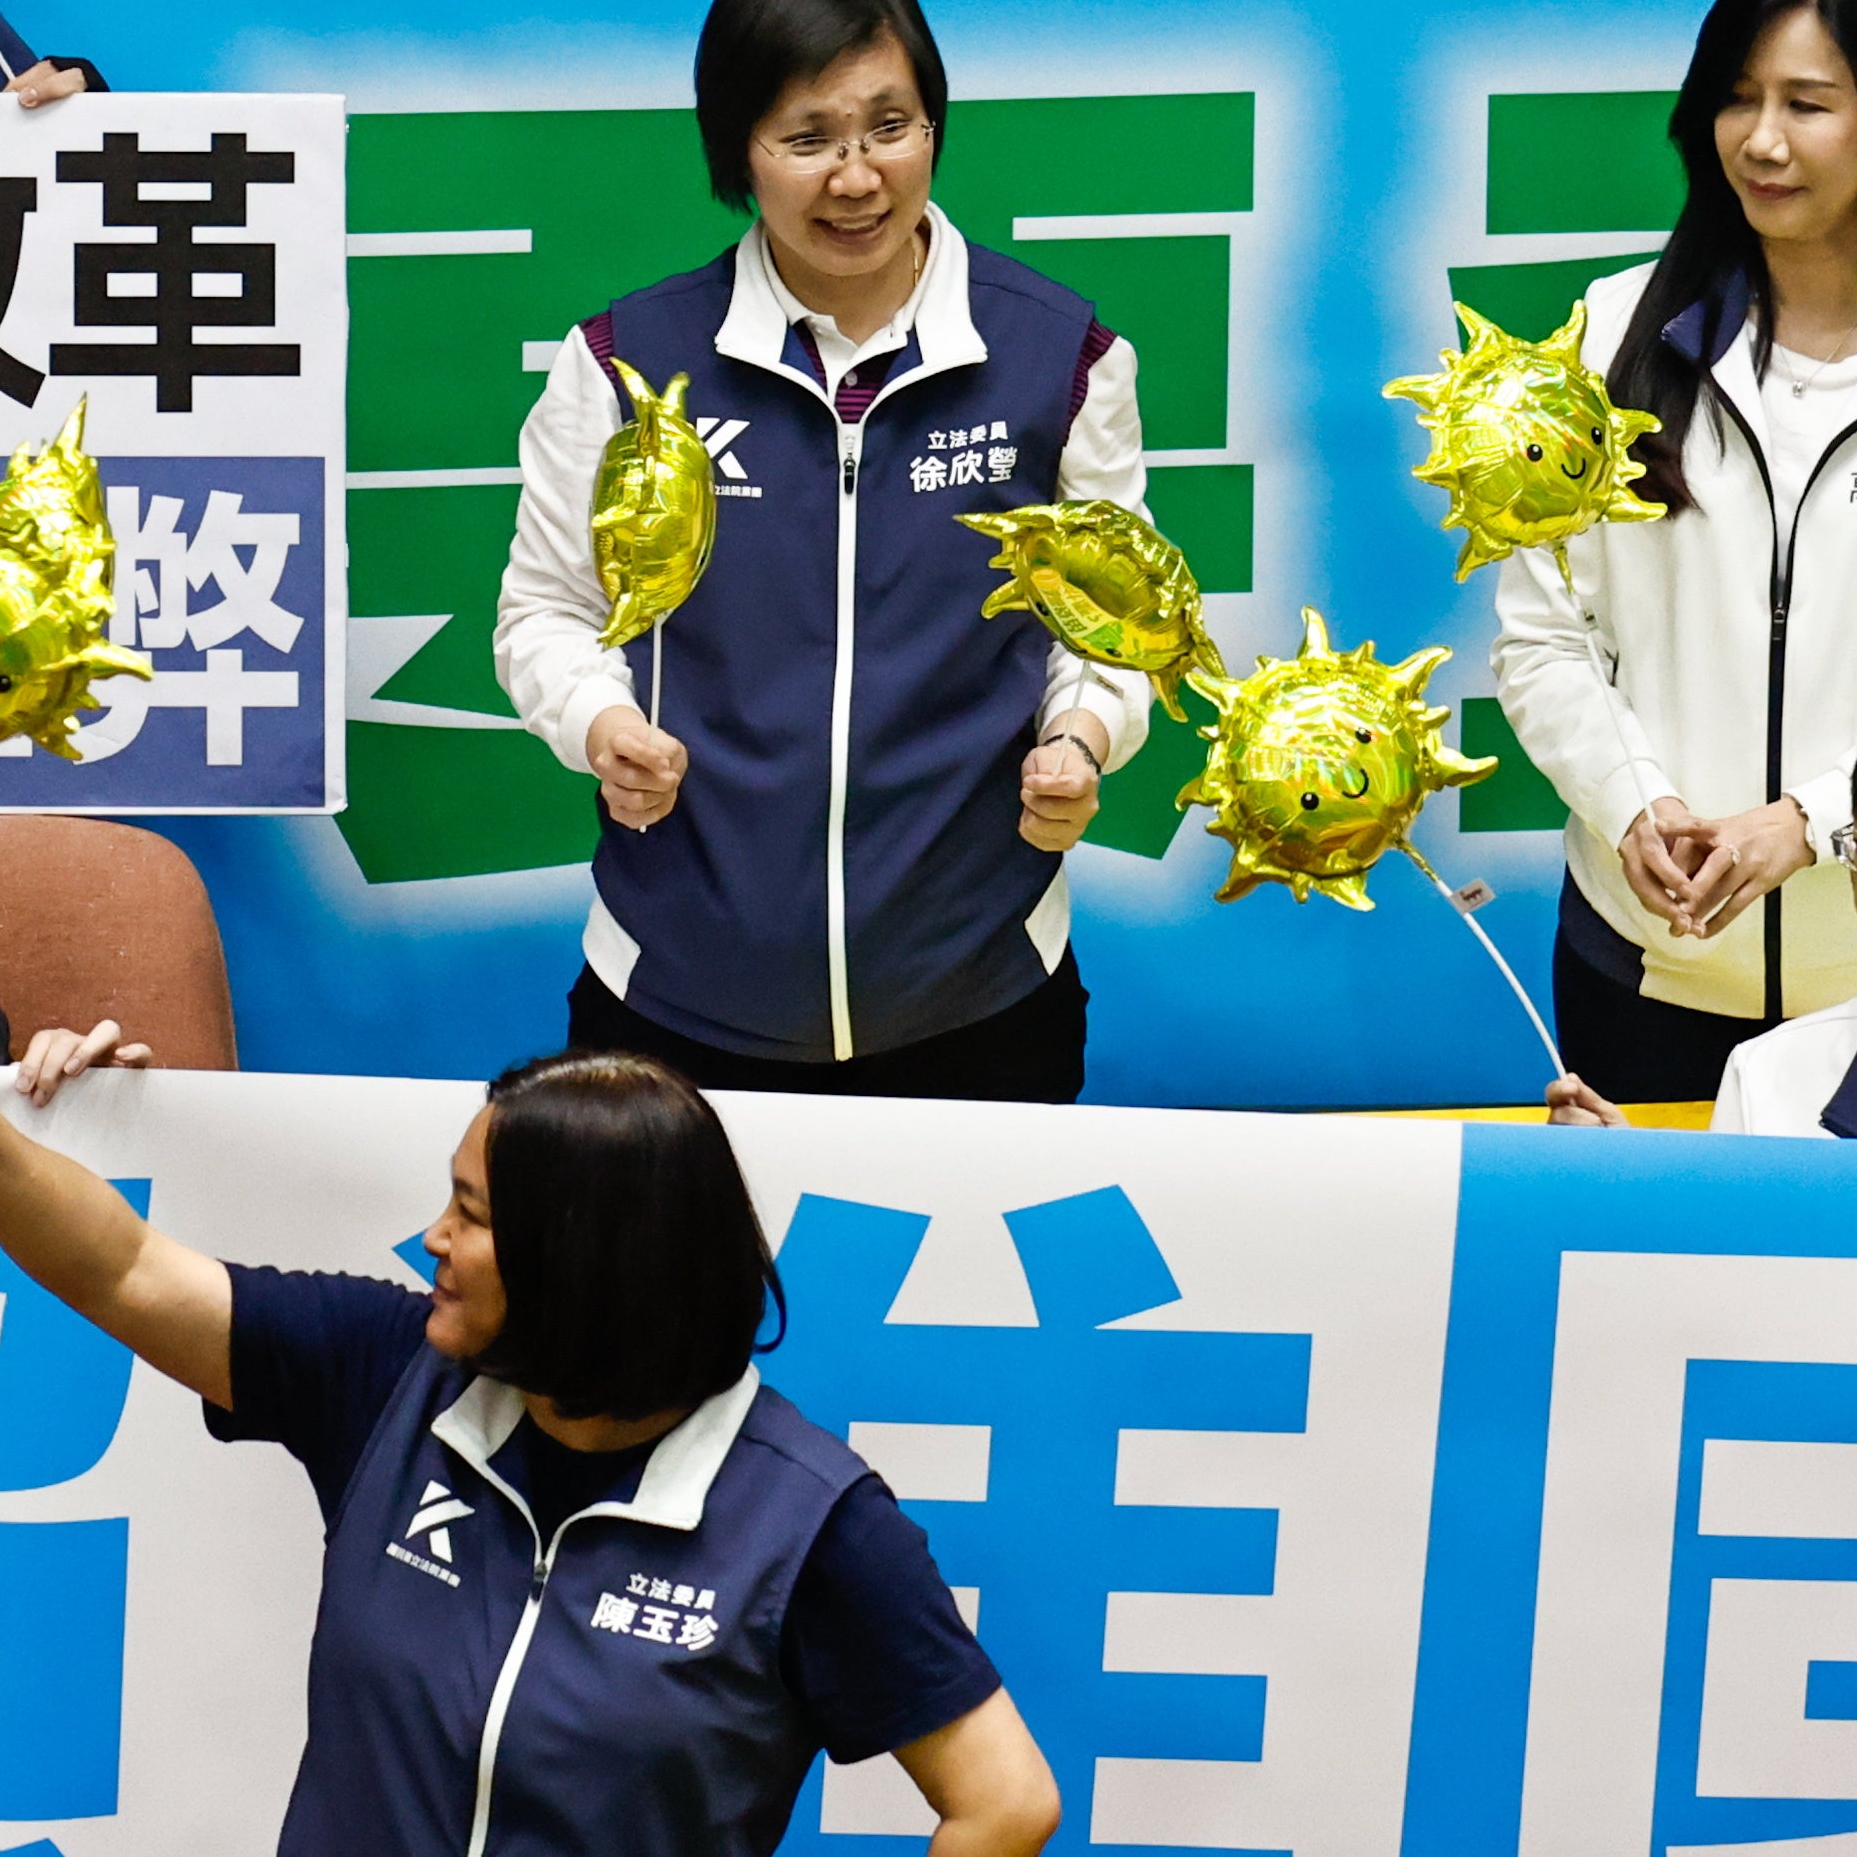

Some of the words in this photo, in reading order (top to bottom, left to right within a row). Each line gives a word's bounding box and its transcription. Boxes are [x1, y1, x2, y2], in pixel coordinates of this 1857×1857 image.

[928, 420, 1008, 450] 立法委員
[909, 446, 1018, 493] 徐欣瑩
[626, 1572, 716, 1610] 立法委員
[591, 1592, 719, 1651] 陳玉珍
